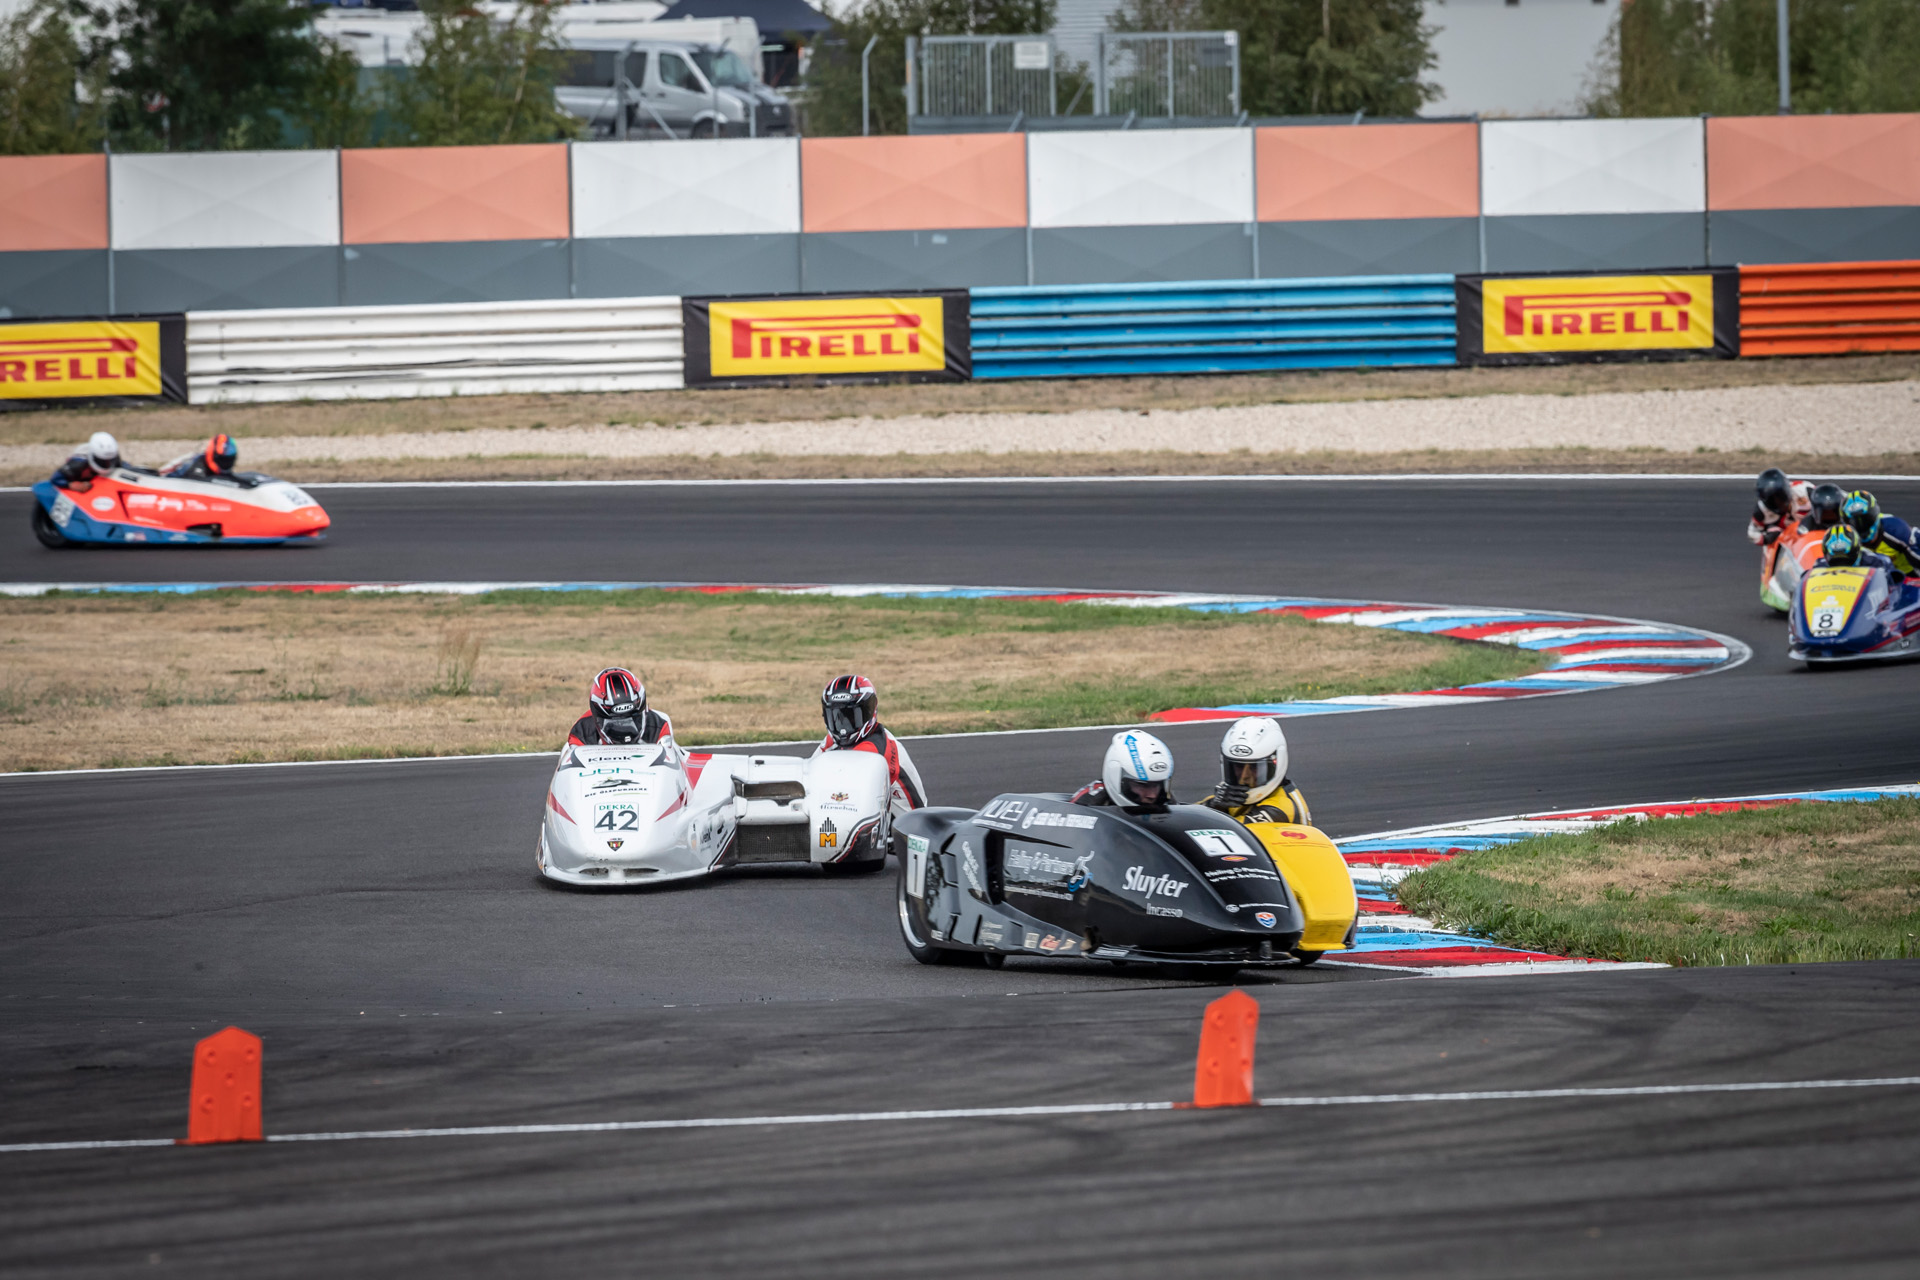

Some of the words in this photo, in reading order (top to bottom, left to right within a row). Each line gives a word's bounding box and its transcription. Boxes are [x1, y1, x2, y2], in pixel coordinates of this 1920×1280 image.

[1504, 291, 1692, 337] PIRELLI
[731, 314, 922, 359] PIRELLI
[1818, 613, 1833, 629] 8
[614, 704, 634, 713] HJC
[588, 755, 633, 763] Klenk
[594, 810, 639, 831] 42
[1211, 835, 1235, 853] 1
[1121, 865, 1189, 899] Sluyter
[1146, 902, 1183, 918] Incasso
